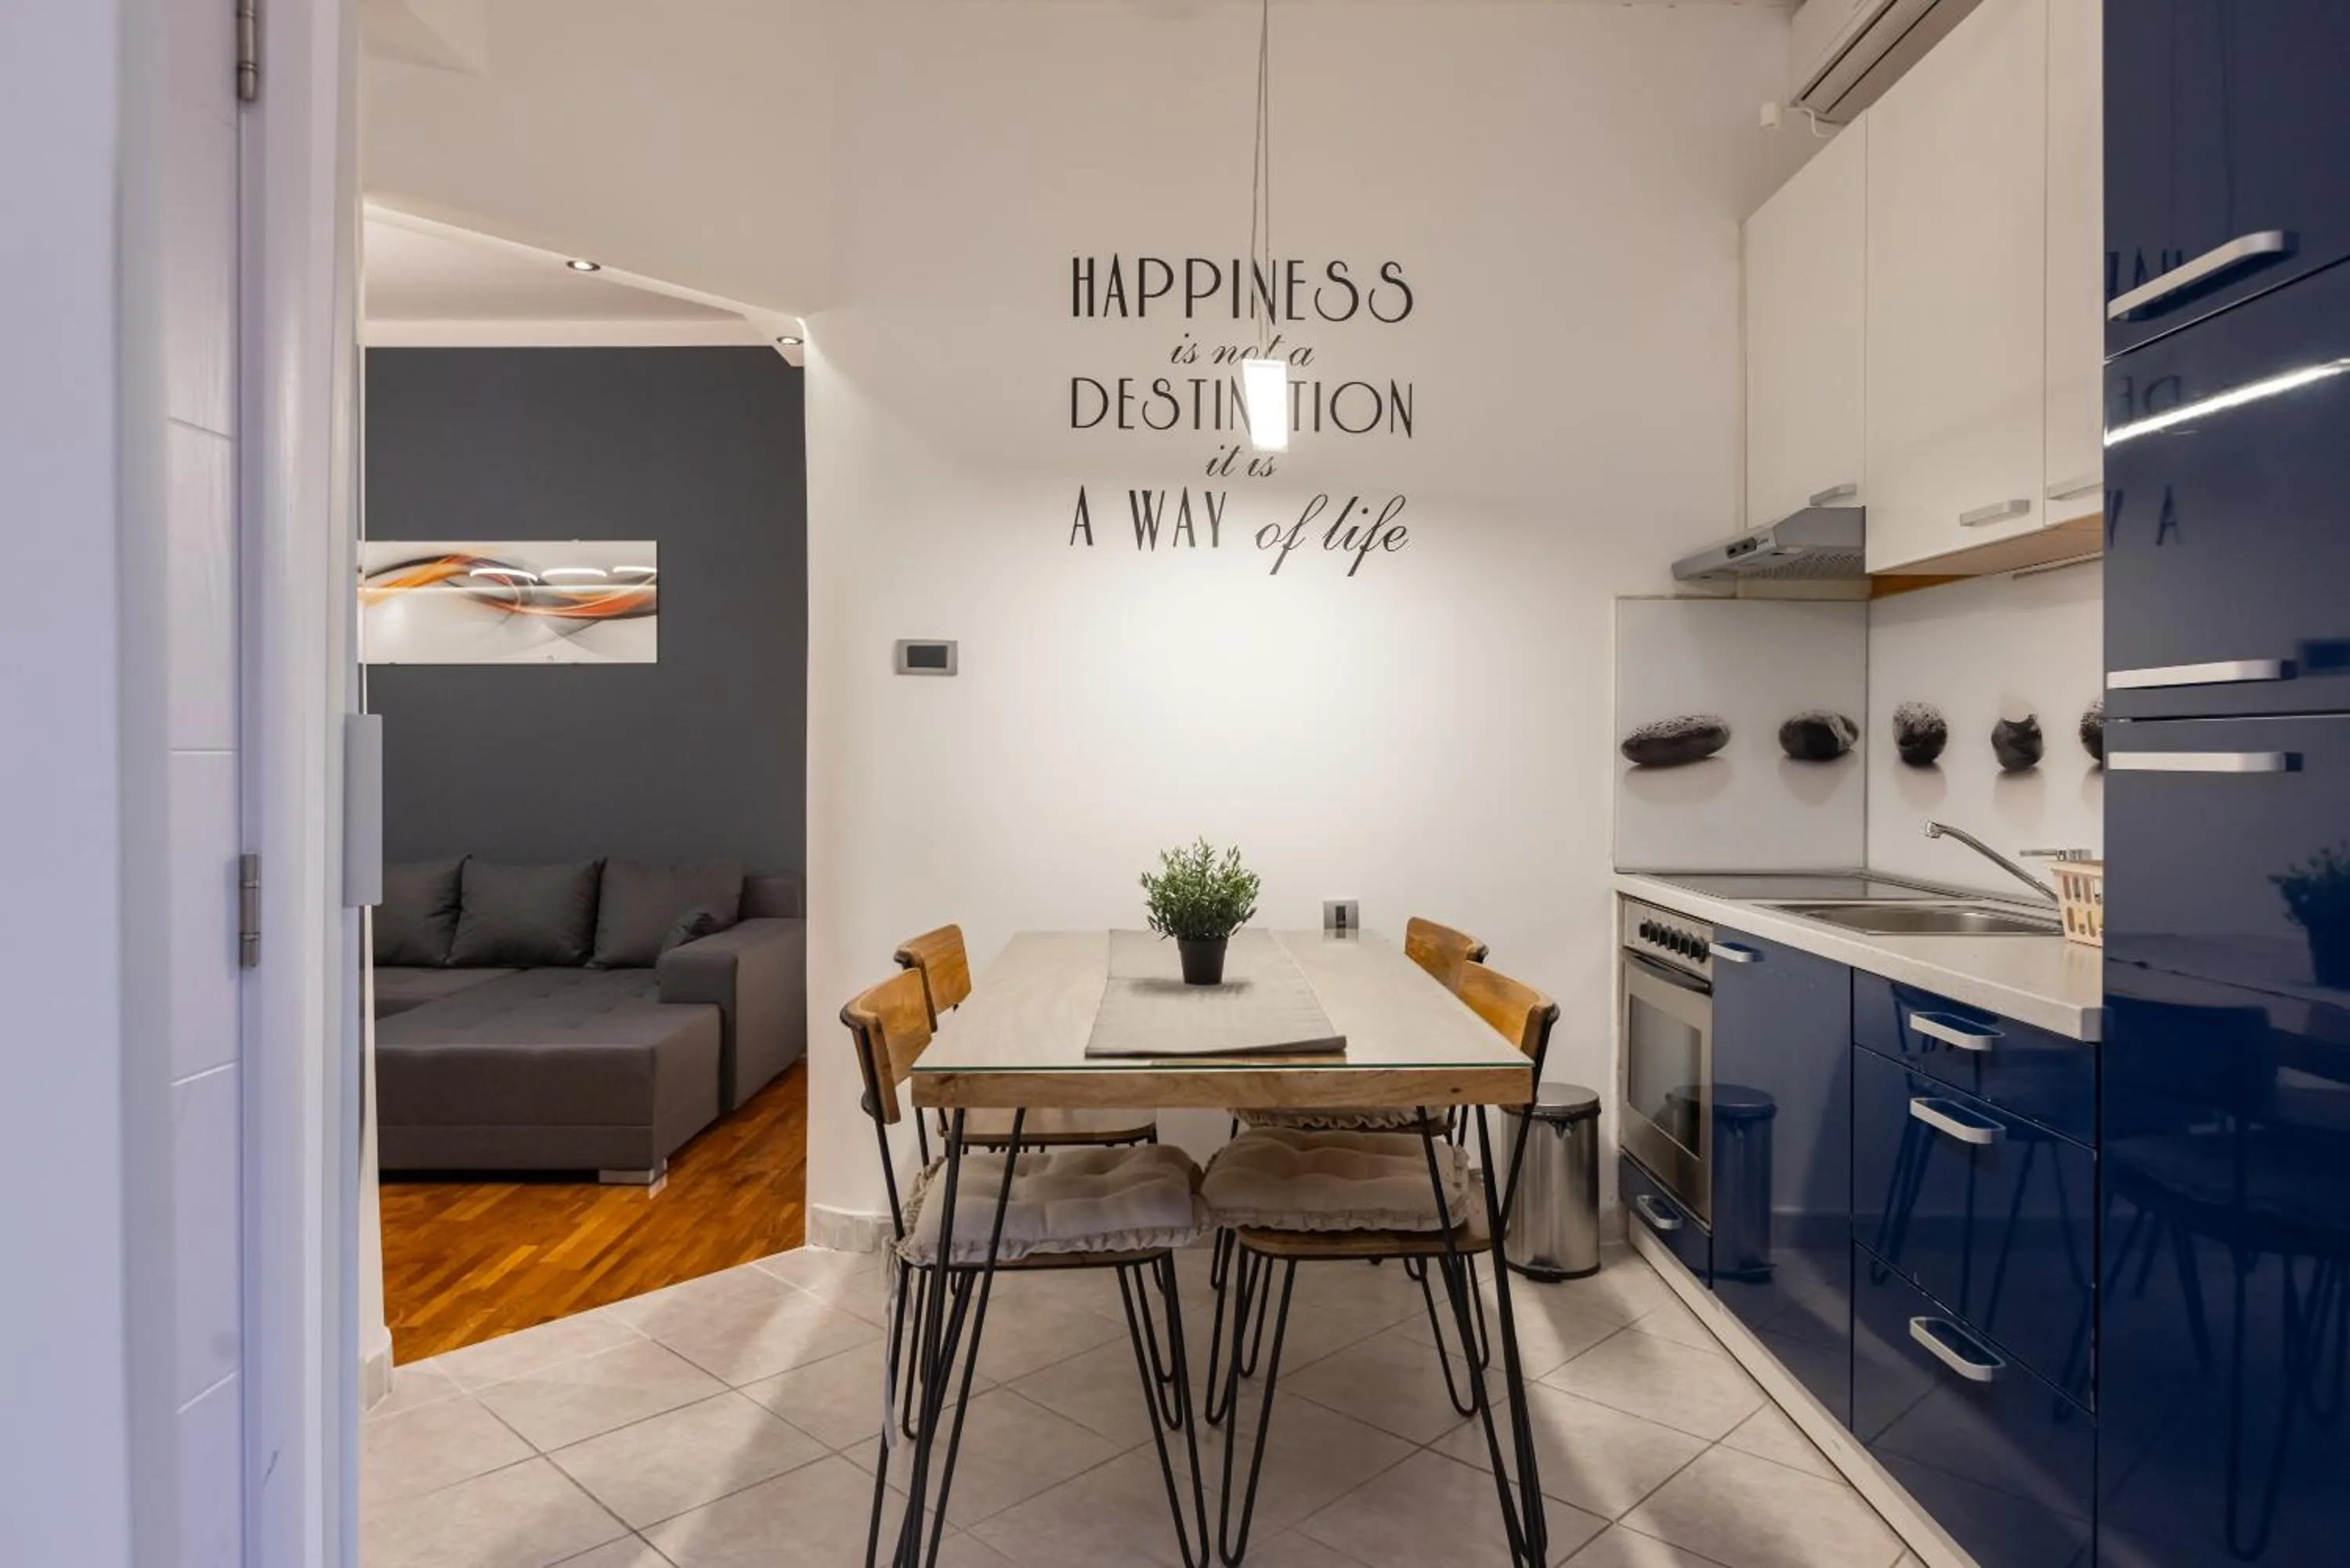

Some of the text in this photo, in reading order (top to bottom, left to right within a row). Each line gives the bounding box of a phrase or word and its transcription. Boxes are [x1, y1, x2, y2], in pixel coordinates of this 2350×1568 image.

[1072, 252, 1414, 326] HAPPINESS
[1170, 333, 1199, 365] is
[1289, 347, 1315, 367] a
[1071, 376, 1413, 439] DESTINTION
[1206, 444, 1277, 478] it is
[1069, 485, 1410, 577] A WAY of life
